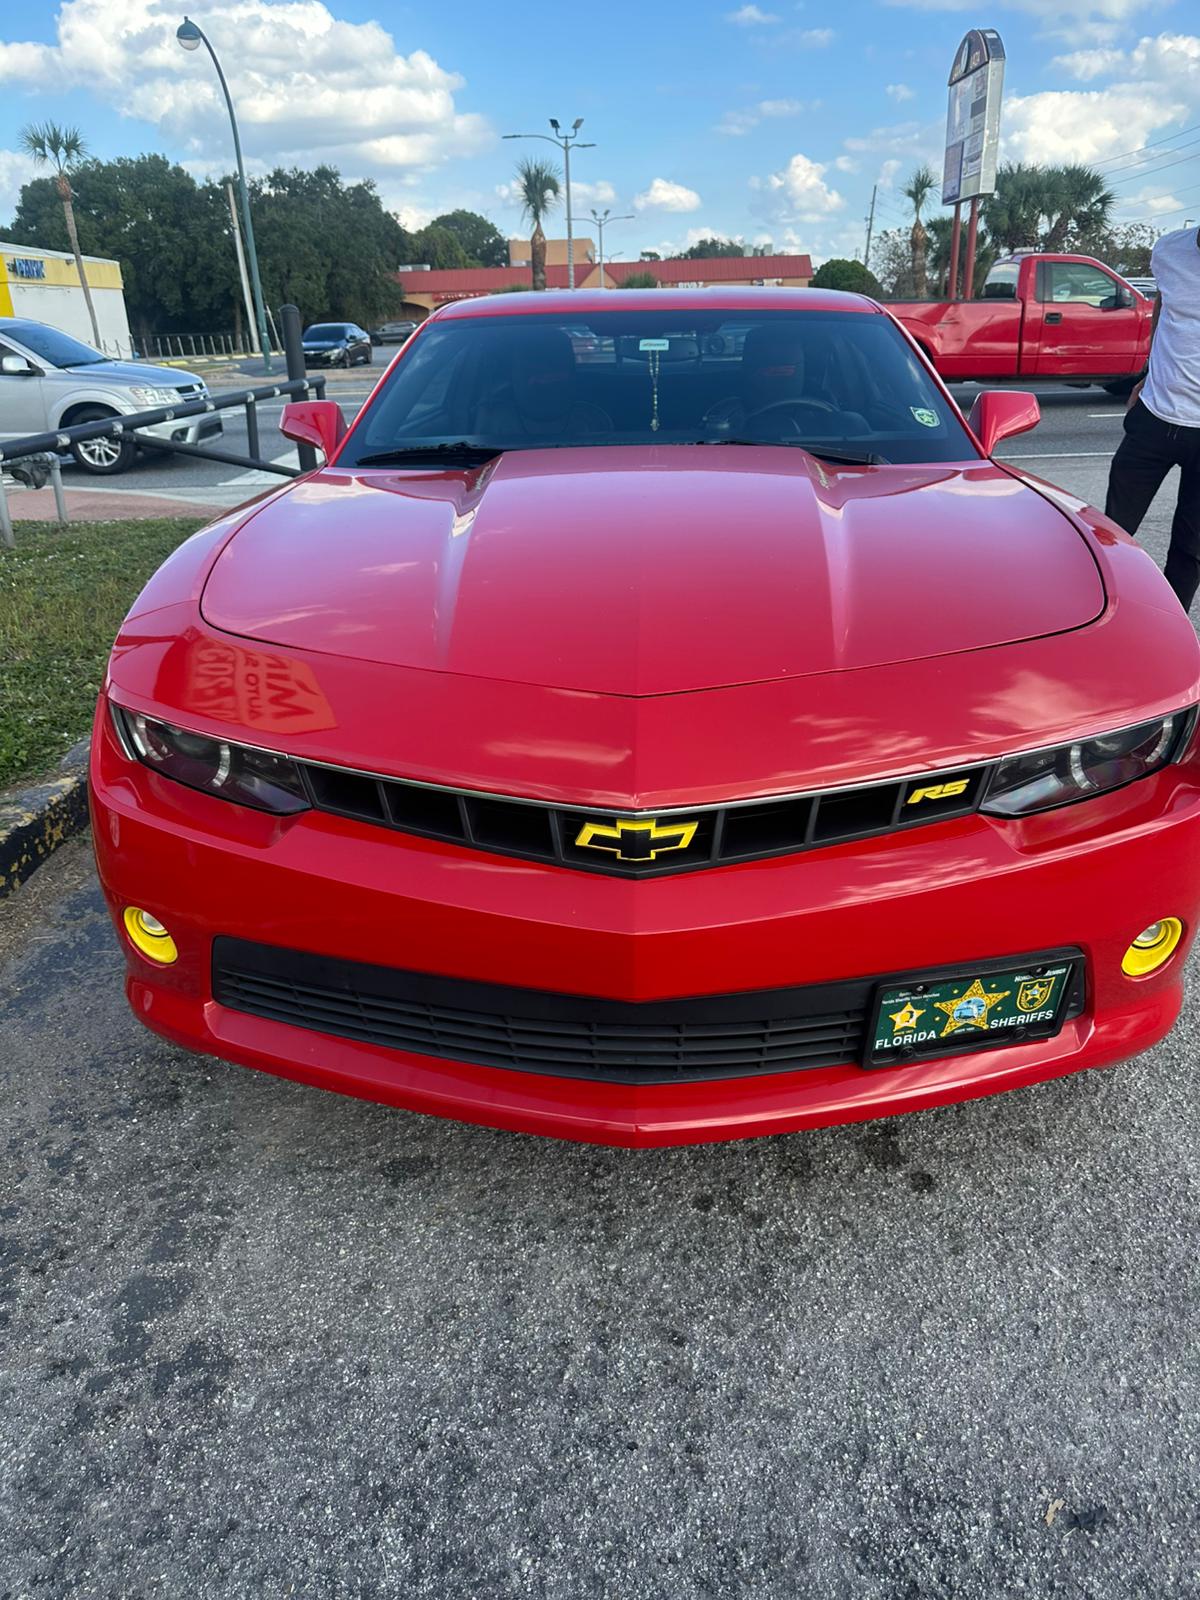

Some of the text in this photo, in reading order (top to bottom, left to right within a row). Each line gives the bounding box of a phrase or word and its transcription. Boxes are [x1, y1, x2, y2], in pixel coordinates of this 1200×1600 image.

[906, 778, 970, 804] RS
[875, 1010, 1053, 1050] FLORIDA SHERIFFS
